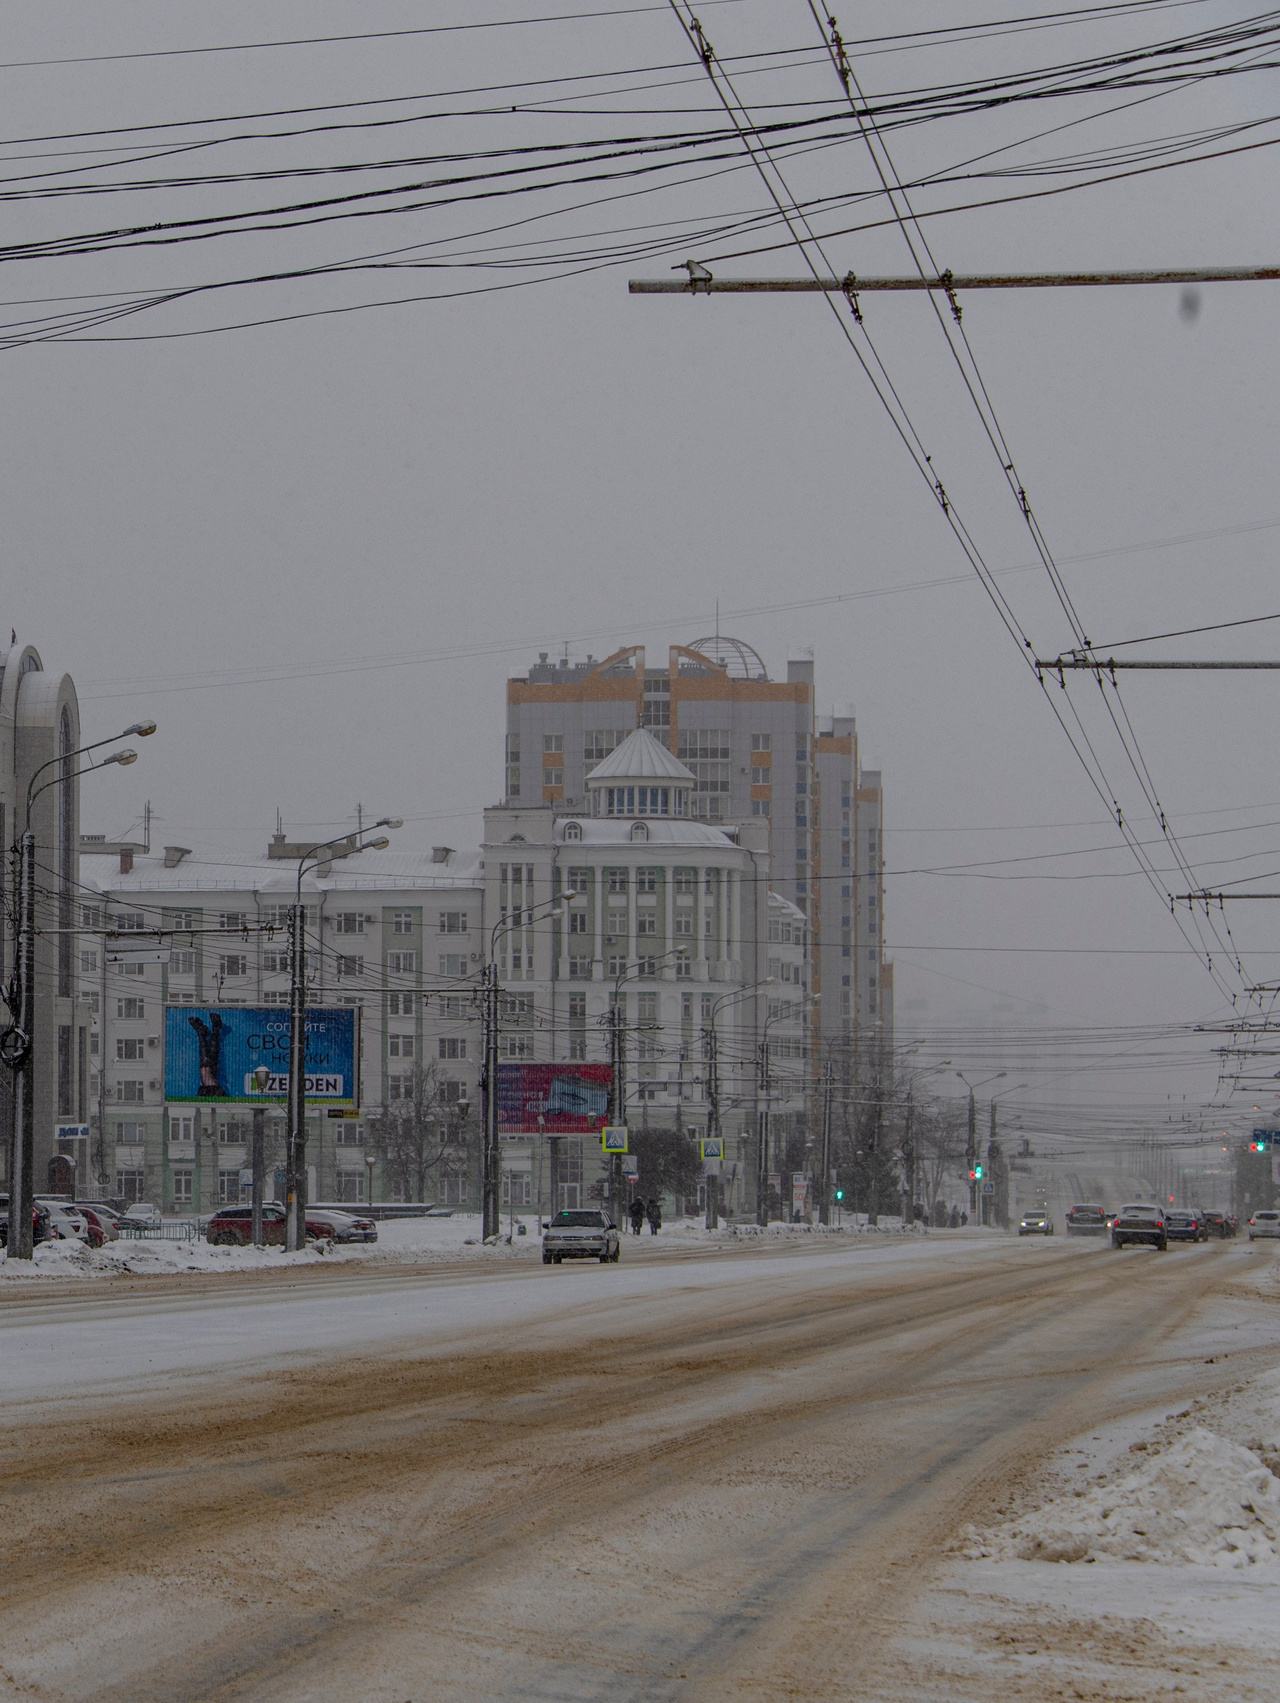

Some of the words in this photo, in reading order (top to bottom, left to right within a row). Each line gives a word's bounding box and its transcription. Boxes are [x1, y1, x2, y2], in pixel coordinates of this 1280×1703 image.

[266, 1022, 327, 1033] СОГЙТЕ
[271, 1052, 330, 1064] НОКИ
[267, 1077, 338, 1092] ZEDEN
